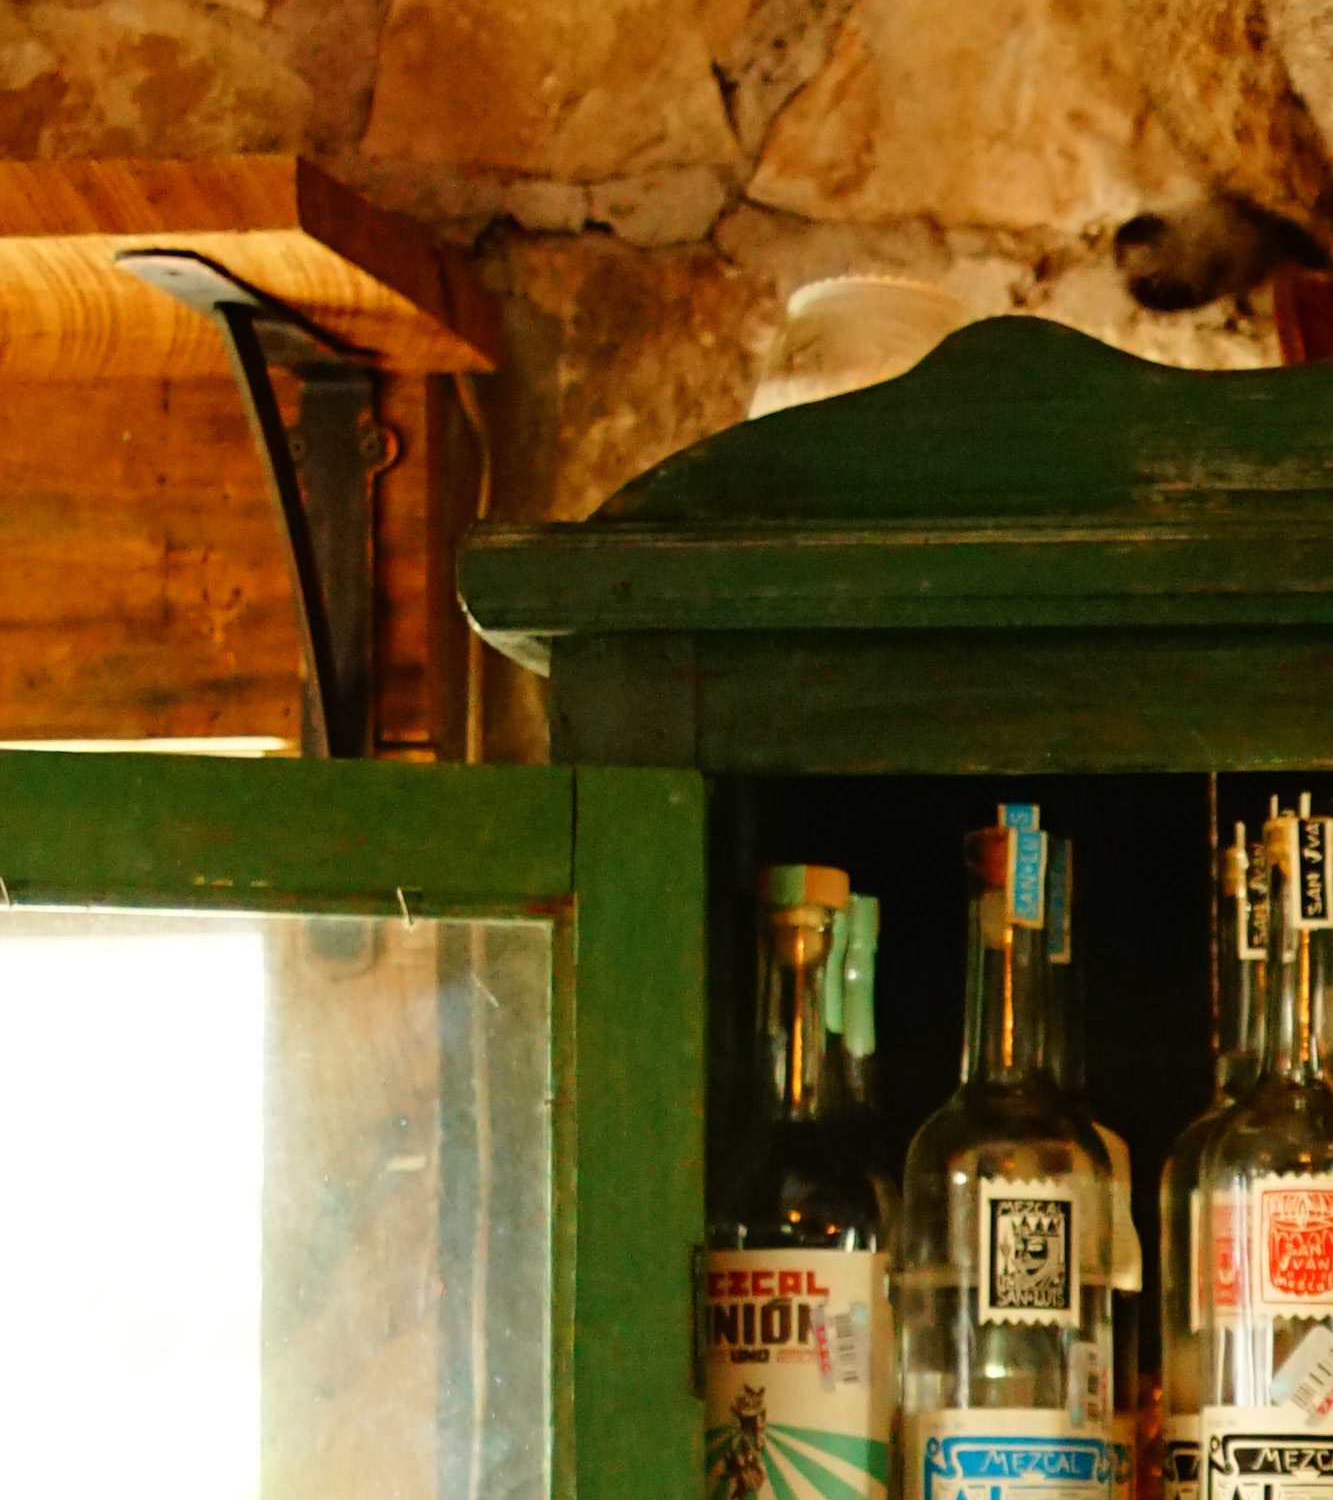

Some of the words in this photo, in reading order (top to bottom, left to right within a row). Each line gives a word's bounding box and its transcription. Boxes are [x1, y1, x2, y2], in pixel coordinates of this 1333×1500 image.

[1307, 821, 1323, 862] JVA
[1307, 872, 1323, 916] SAN
[1000, 1202, 1063, 1216] MEZCAL
[708, 1270, 830, 1297] EZCAL
[711, 1298, 811, 1345] NIÓ
[980, 1452, 1082, 1475] MEZCAL
